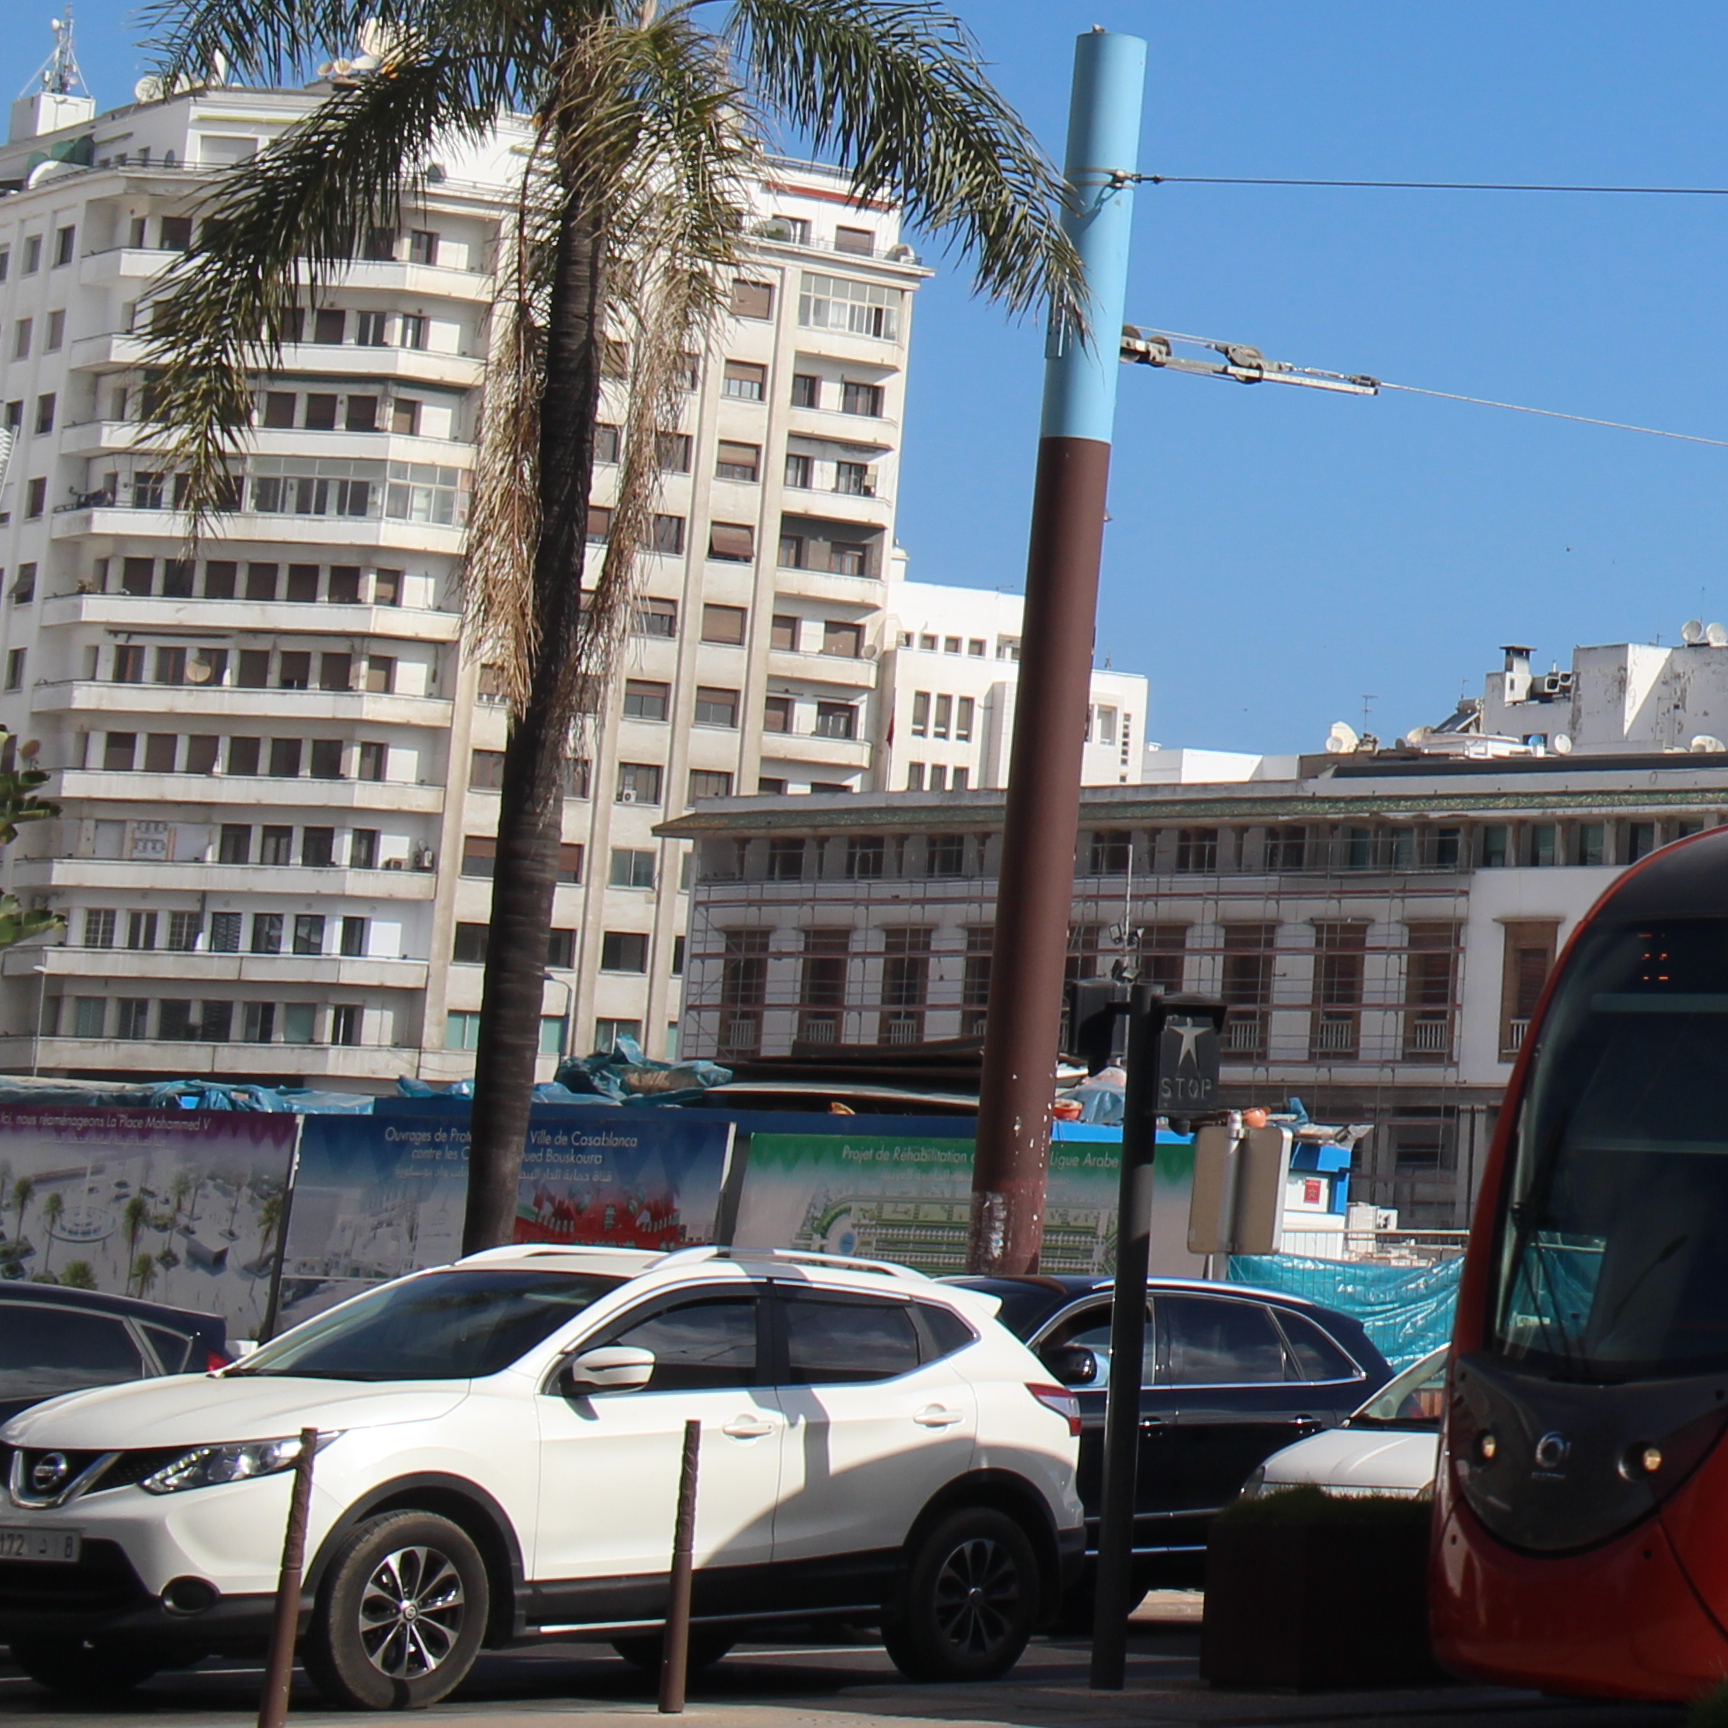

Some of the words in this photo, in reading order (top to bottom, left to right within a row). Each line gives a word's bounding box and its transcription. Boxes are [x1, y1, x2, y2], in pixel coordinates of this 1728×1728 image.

[1161, 1077, 1212, 1099] STOP
[118, 1114, 144, 1128] Place
[145, 1115, 201, 1130] Mohammed
[385, 1126, 432, 1146] Ouvrages
[434, 1127, 448, 1142] de
[530, 1129, 552, 1145] Ville
[554, 1129, 568, 1145] de
[571, 1130, 639, 1147] Casablanca
[411, 1147, 442, 1160] contre
[444, 1145, 459, 1160] les
[546, 1148, 603, 1164] Bouskoura
[842, 1144, 873, 1165] Projet
[875, 1145, 890, 1161] de
[893, 1145, 967, 1163] Réhabilitation
[1050, 1150, 1080, 1170] Ligue
[1083, 1149, 1119, 1168] Arabe
